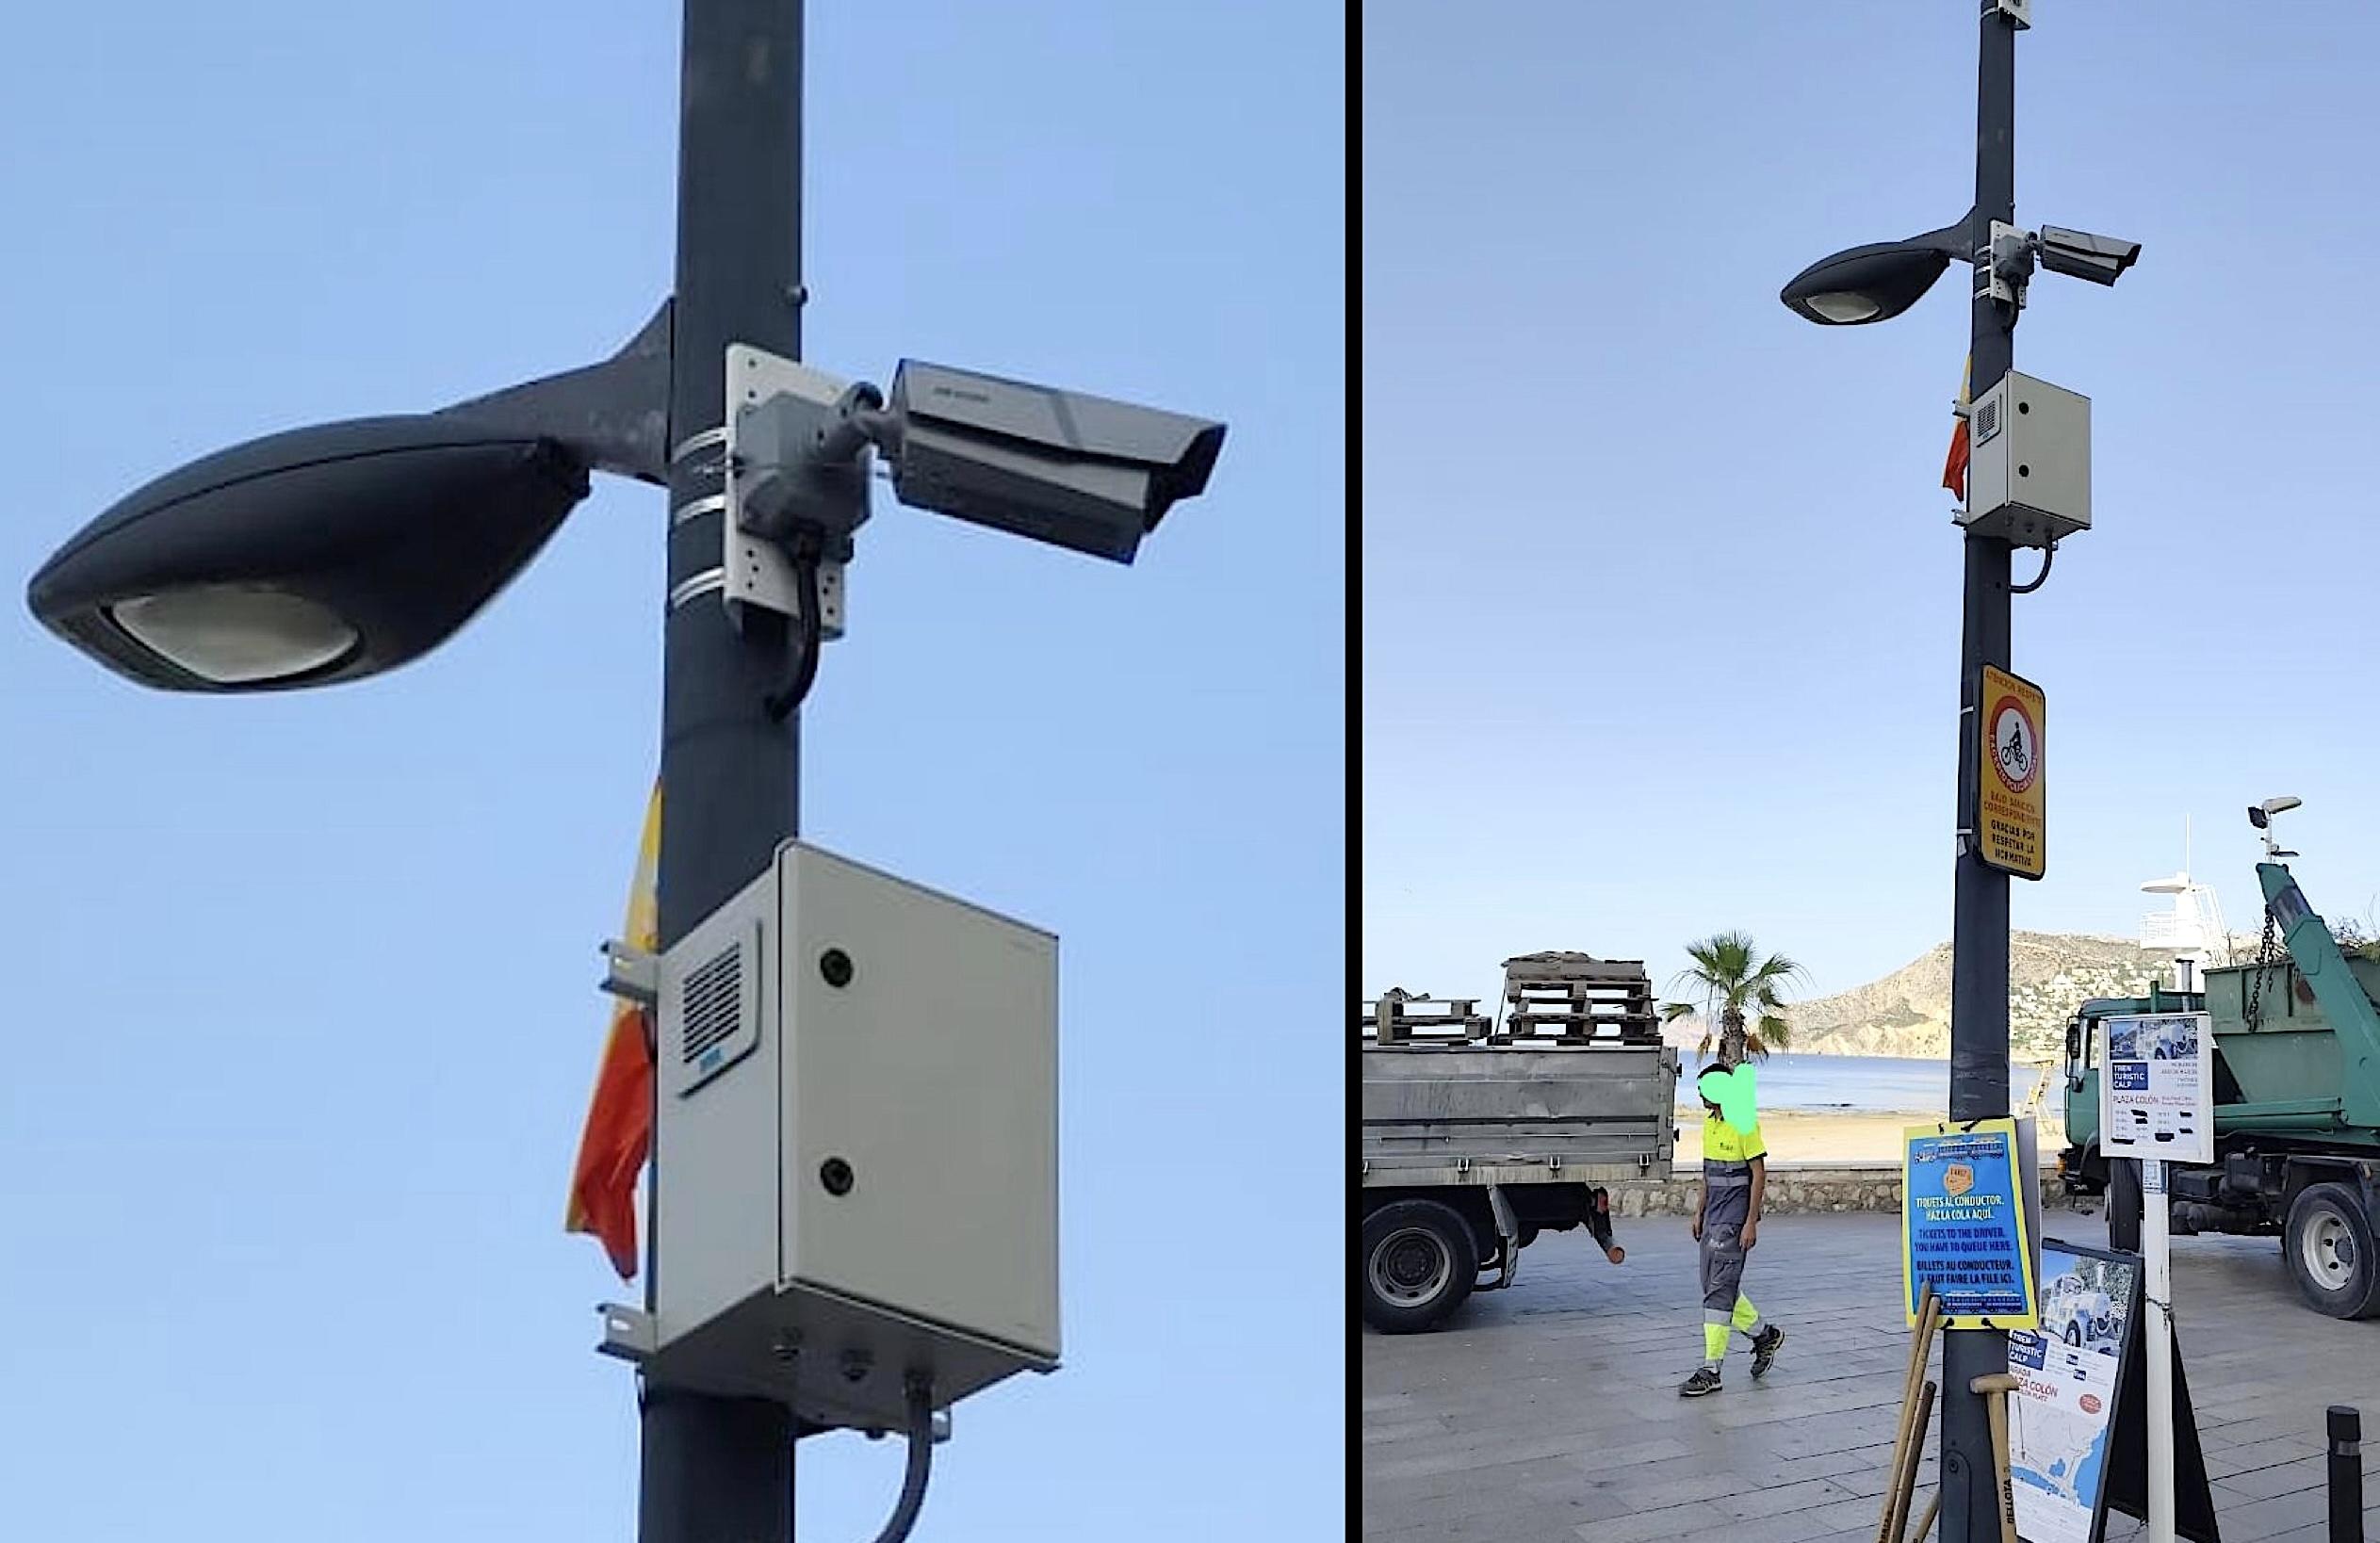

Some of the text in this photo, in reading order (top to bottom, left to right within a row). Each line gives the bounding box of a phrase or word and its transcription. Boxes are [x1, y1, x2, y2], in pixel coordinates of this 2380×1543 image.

[1991, 819, 2035, 842] GRACIAS POR
[1992, 833, 2035, 853] RESPETAR LA
[1995, 847, 2032, 867] NORMATIVA
[2112, 1095, 2134, 1103] PLAZA
[1947, 1228, 1956, 1239] TO
[1957, 1228, 1972, 1239] THE
[1915, 1242, 1929, 1252] YOU
[1930, 1242, 1948, 1252] HAVE
[1949, 1242, 1960, 1252] TO
[1961, 1241, 1988, 1253] QUEUE
[1916, 1260, 1944, 1271] BILLETS
[1946, 1273, 1967, 1284] FAIRE
